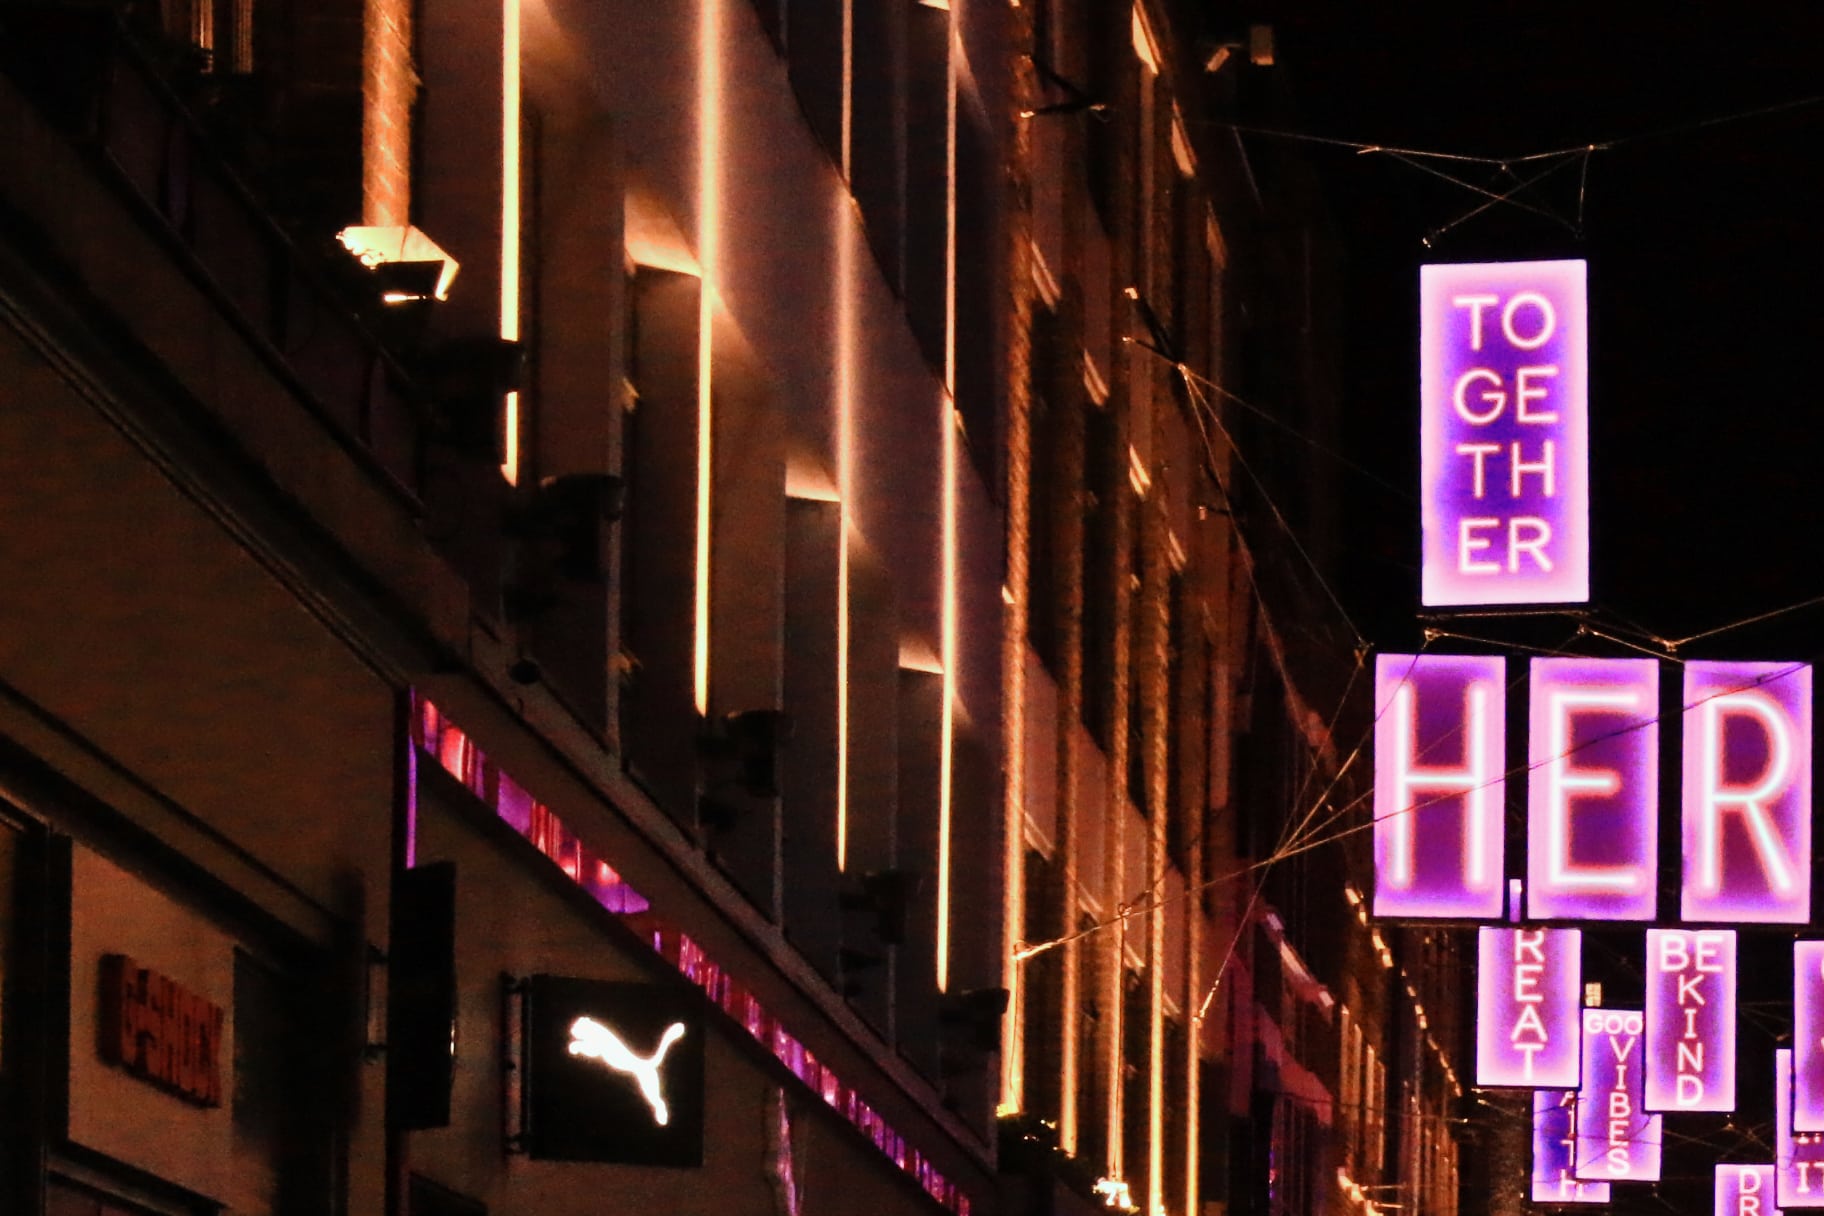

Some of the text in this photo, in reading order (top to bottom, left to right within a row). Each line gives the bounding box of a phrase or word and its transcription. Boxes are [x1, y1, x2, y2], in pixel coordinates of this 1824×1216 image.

[1511, 929, 1549, 1081] REAT
[1659, 934, 1723, 1107] BE KIND
[1584, 1013, 1643, 1176] GOO VIBES
